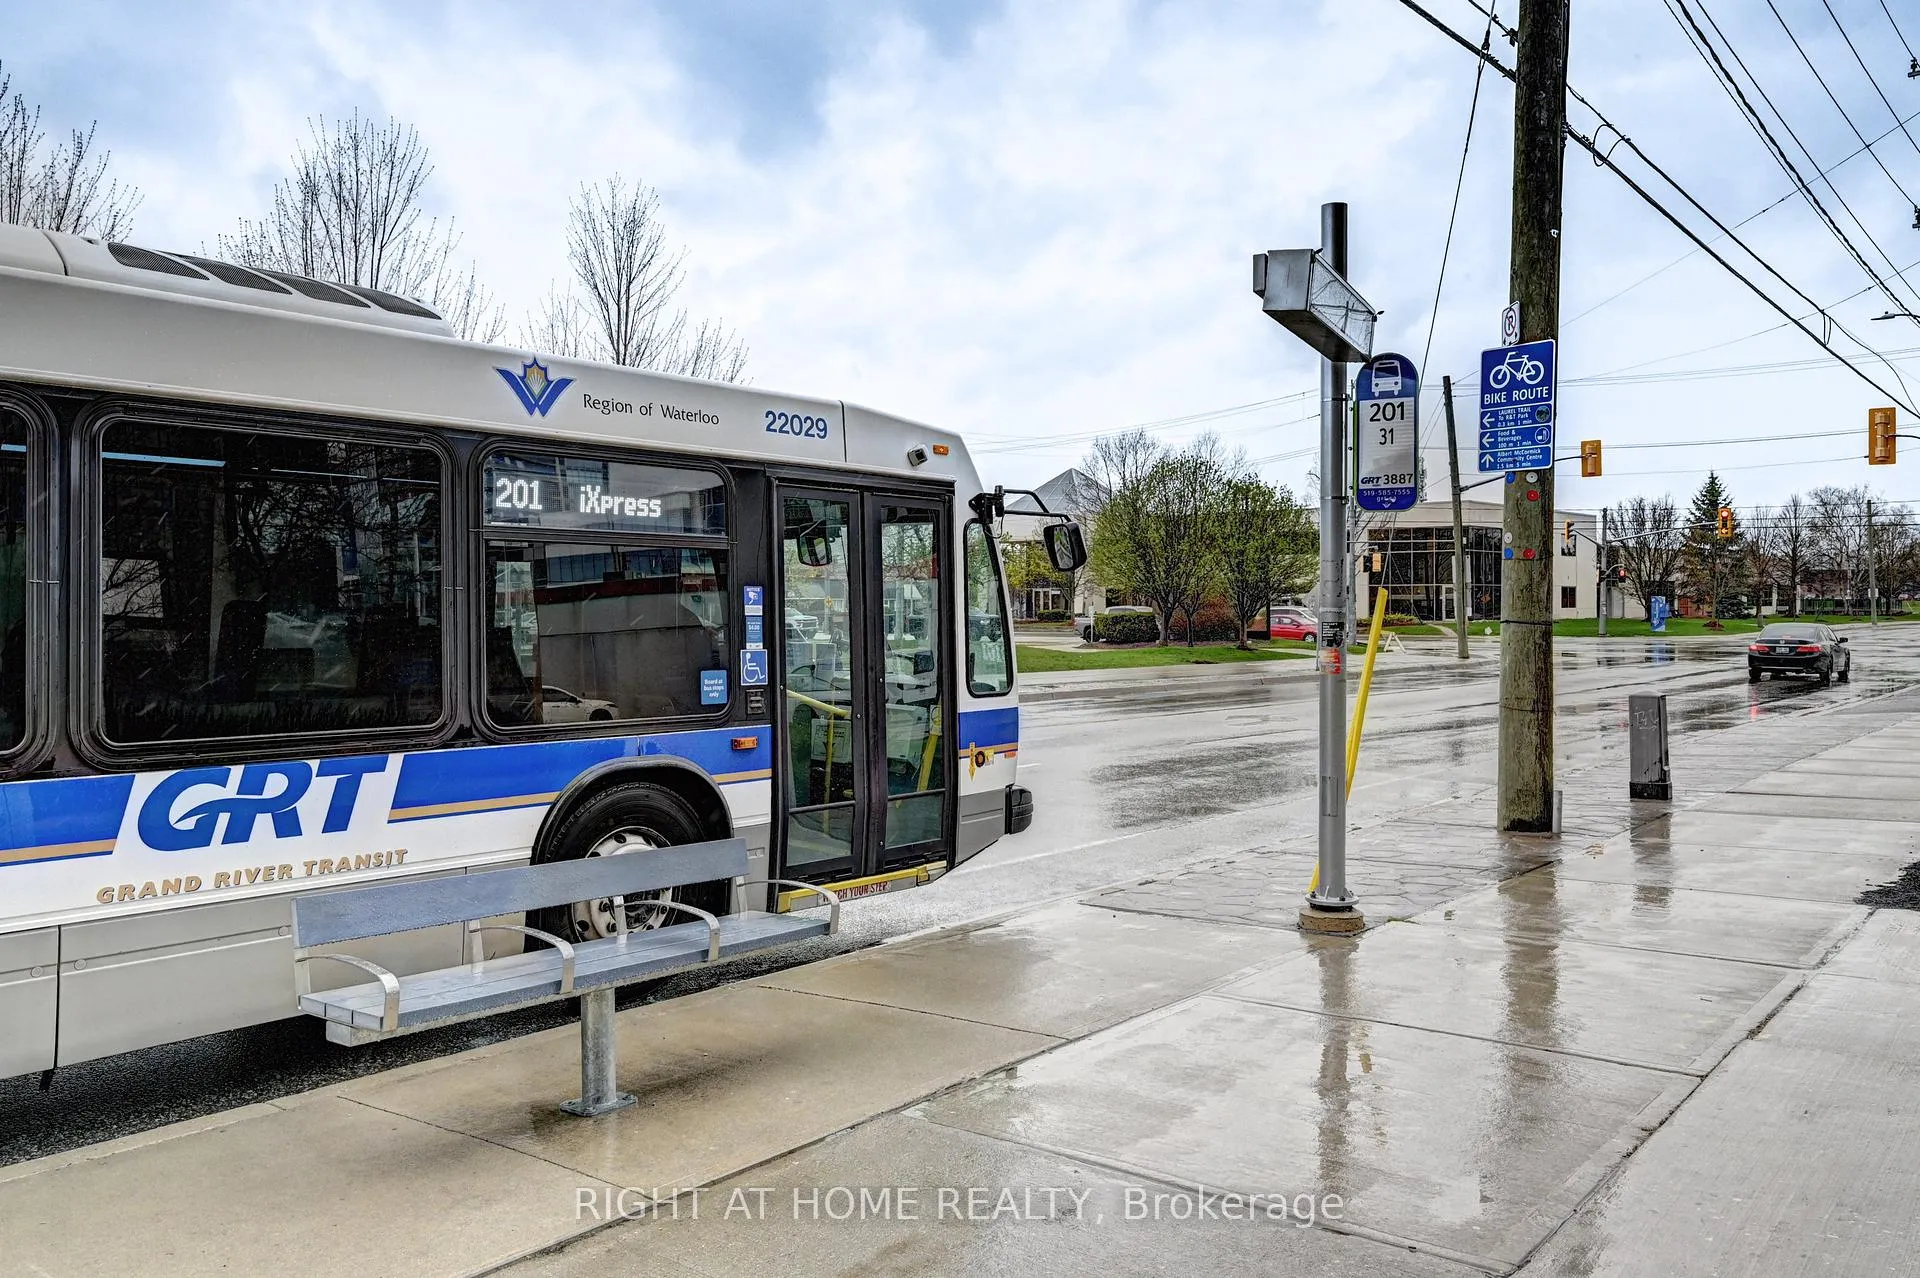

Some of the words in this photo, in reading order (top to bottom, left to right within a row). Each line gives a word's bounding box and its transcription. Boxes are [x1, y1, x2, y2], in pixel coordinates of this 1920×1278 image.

[1484, 392, 1507, 405] BIKE
[1512, 386, 1549, 401] ROUTE
[583, 393, 633, 415] Region
[639, 403, 653, 417] of
[660, 404, 720, 425] Waterloo
[1369, 401, 1405, 422] 201
[764, 410, 828, 439] 22029
[1379, 428, 1394, 445] 31
[1514, 448, 1541, 456] McCormick
[1361, 476, 1382, 484] GRT
[1383, 473, 1413, 485] 3887
[495, 478, 543, 511] 201
[579, 484, 662, 518] iXpress
[137, 753, 389, 852] GRT
[96, 874, 202, 904] GRAND
[214, 863, 293, 889] RIVER
[303, 849, 409, 877] TRANSIT
[850, 885, 869, 898] YOUR
[870, 880, 888, 894] STEP
